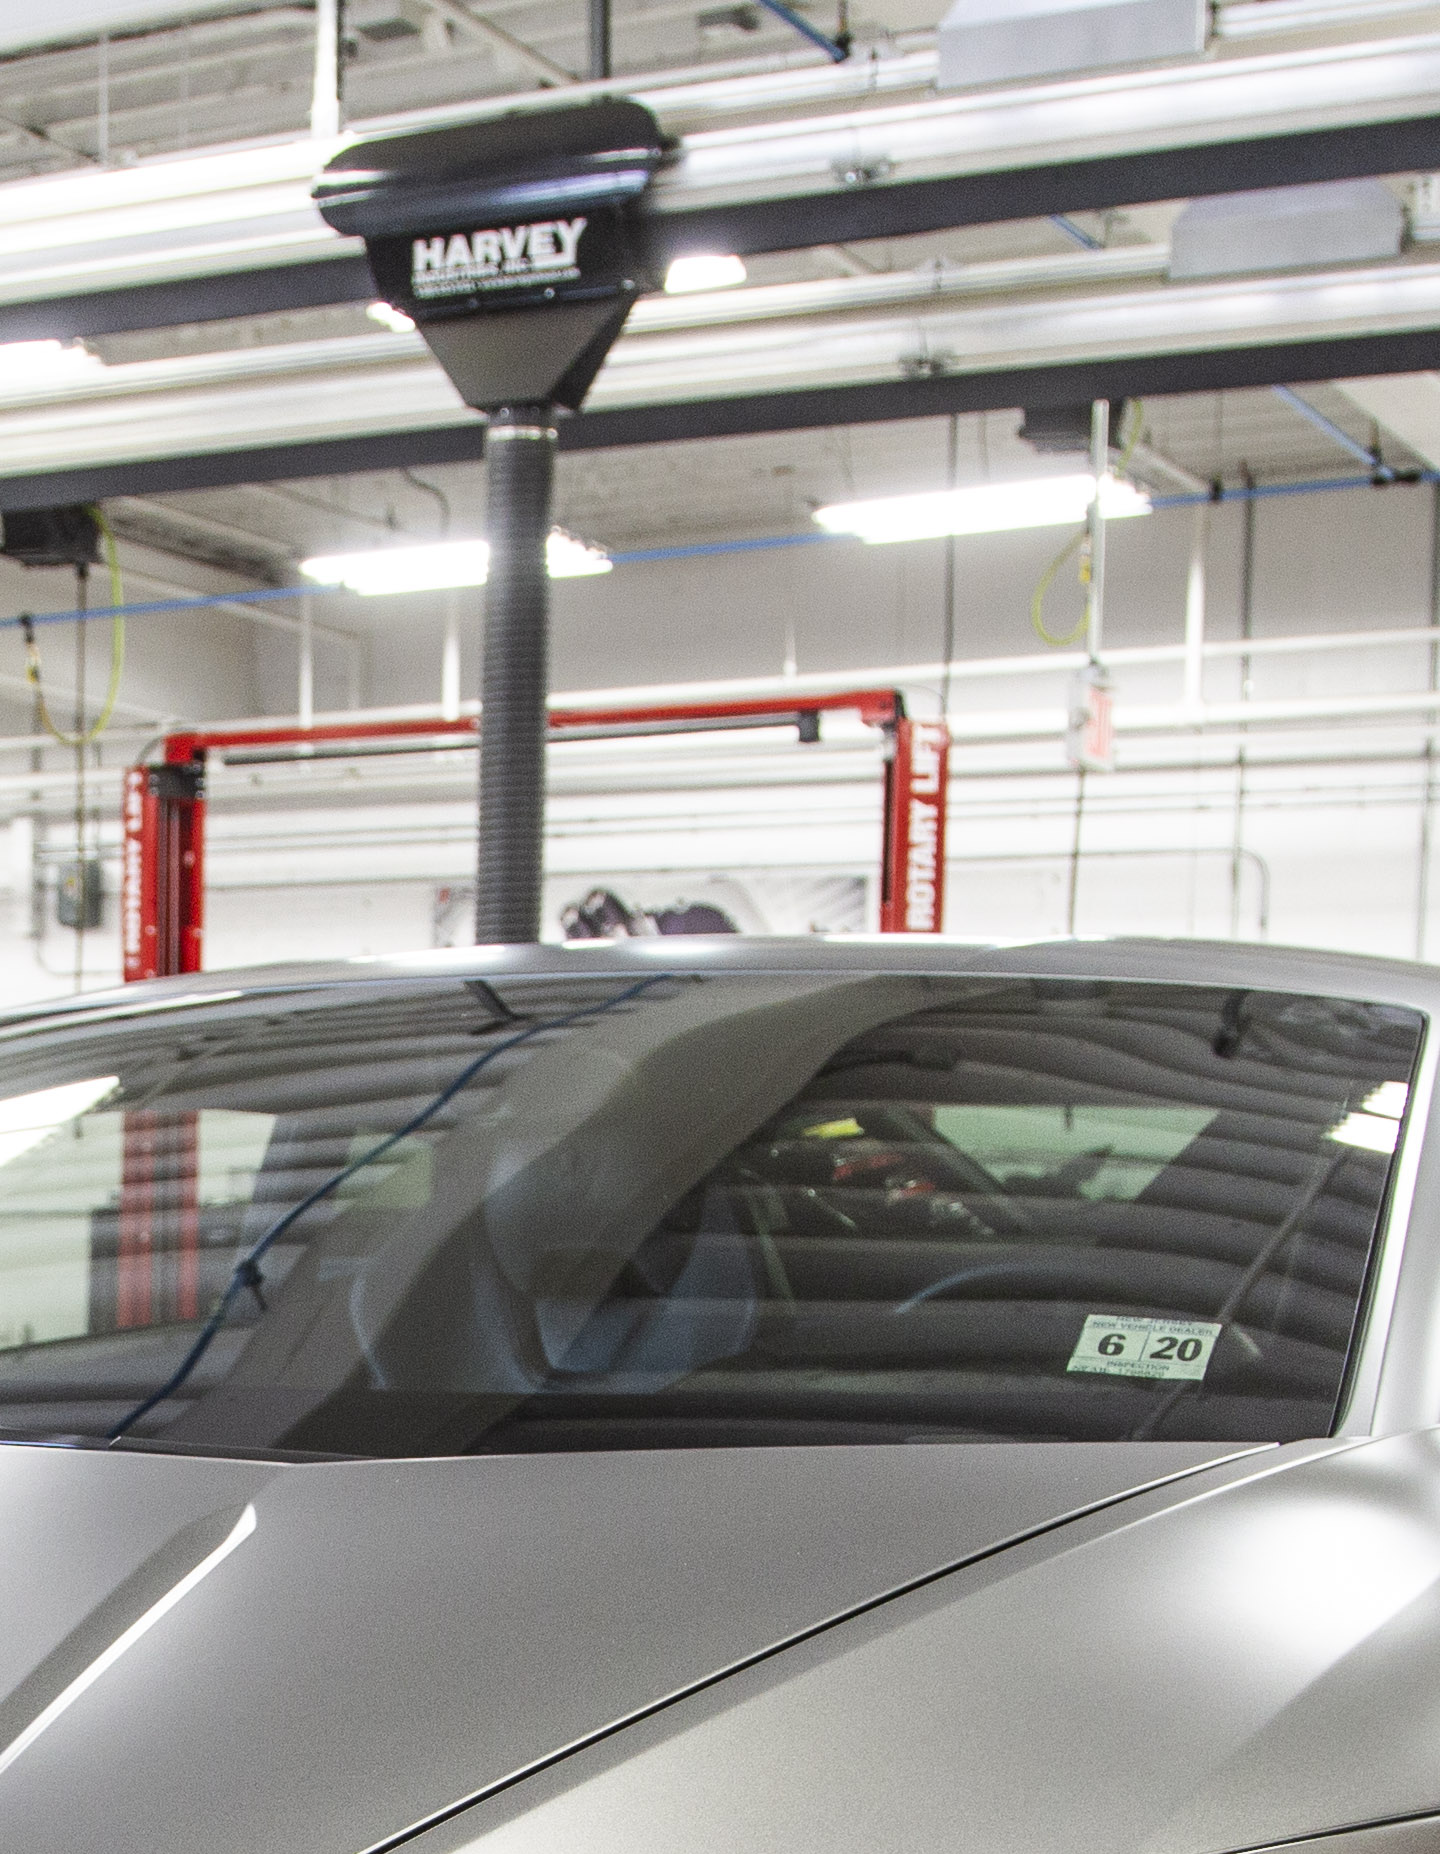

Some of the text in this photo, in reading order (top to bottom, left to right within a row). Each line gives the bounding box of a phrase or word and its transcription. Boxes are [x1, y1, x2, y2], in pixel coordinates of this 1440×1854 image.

[413, 217, 588, 271] HARVEY
[907, 726, 941, 930] ROTARY LIFT
[1098, 1333, 1203, 1362] 6 20
